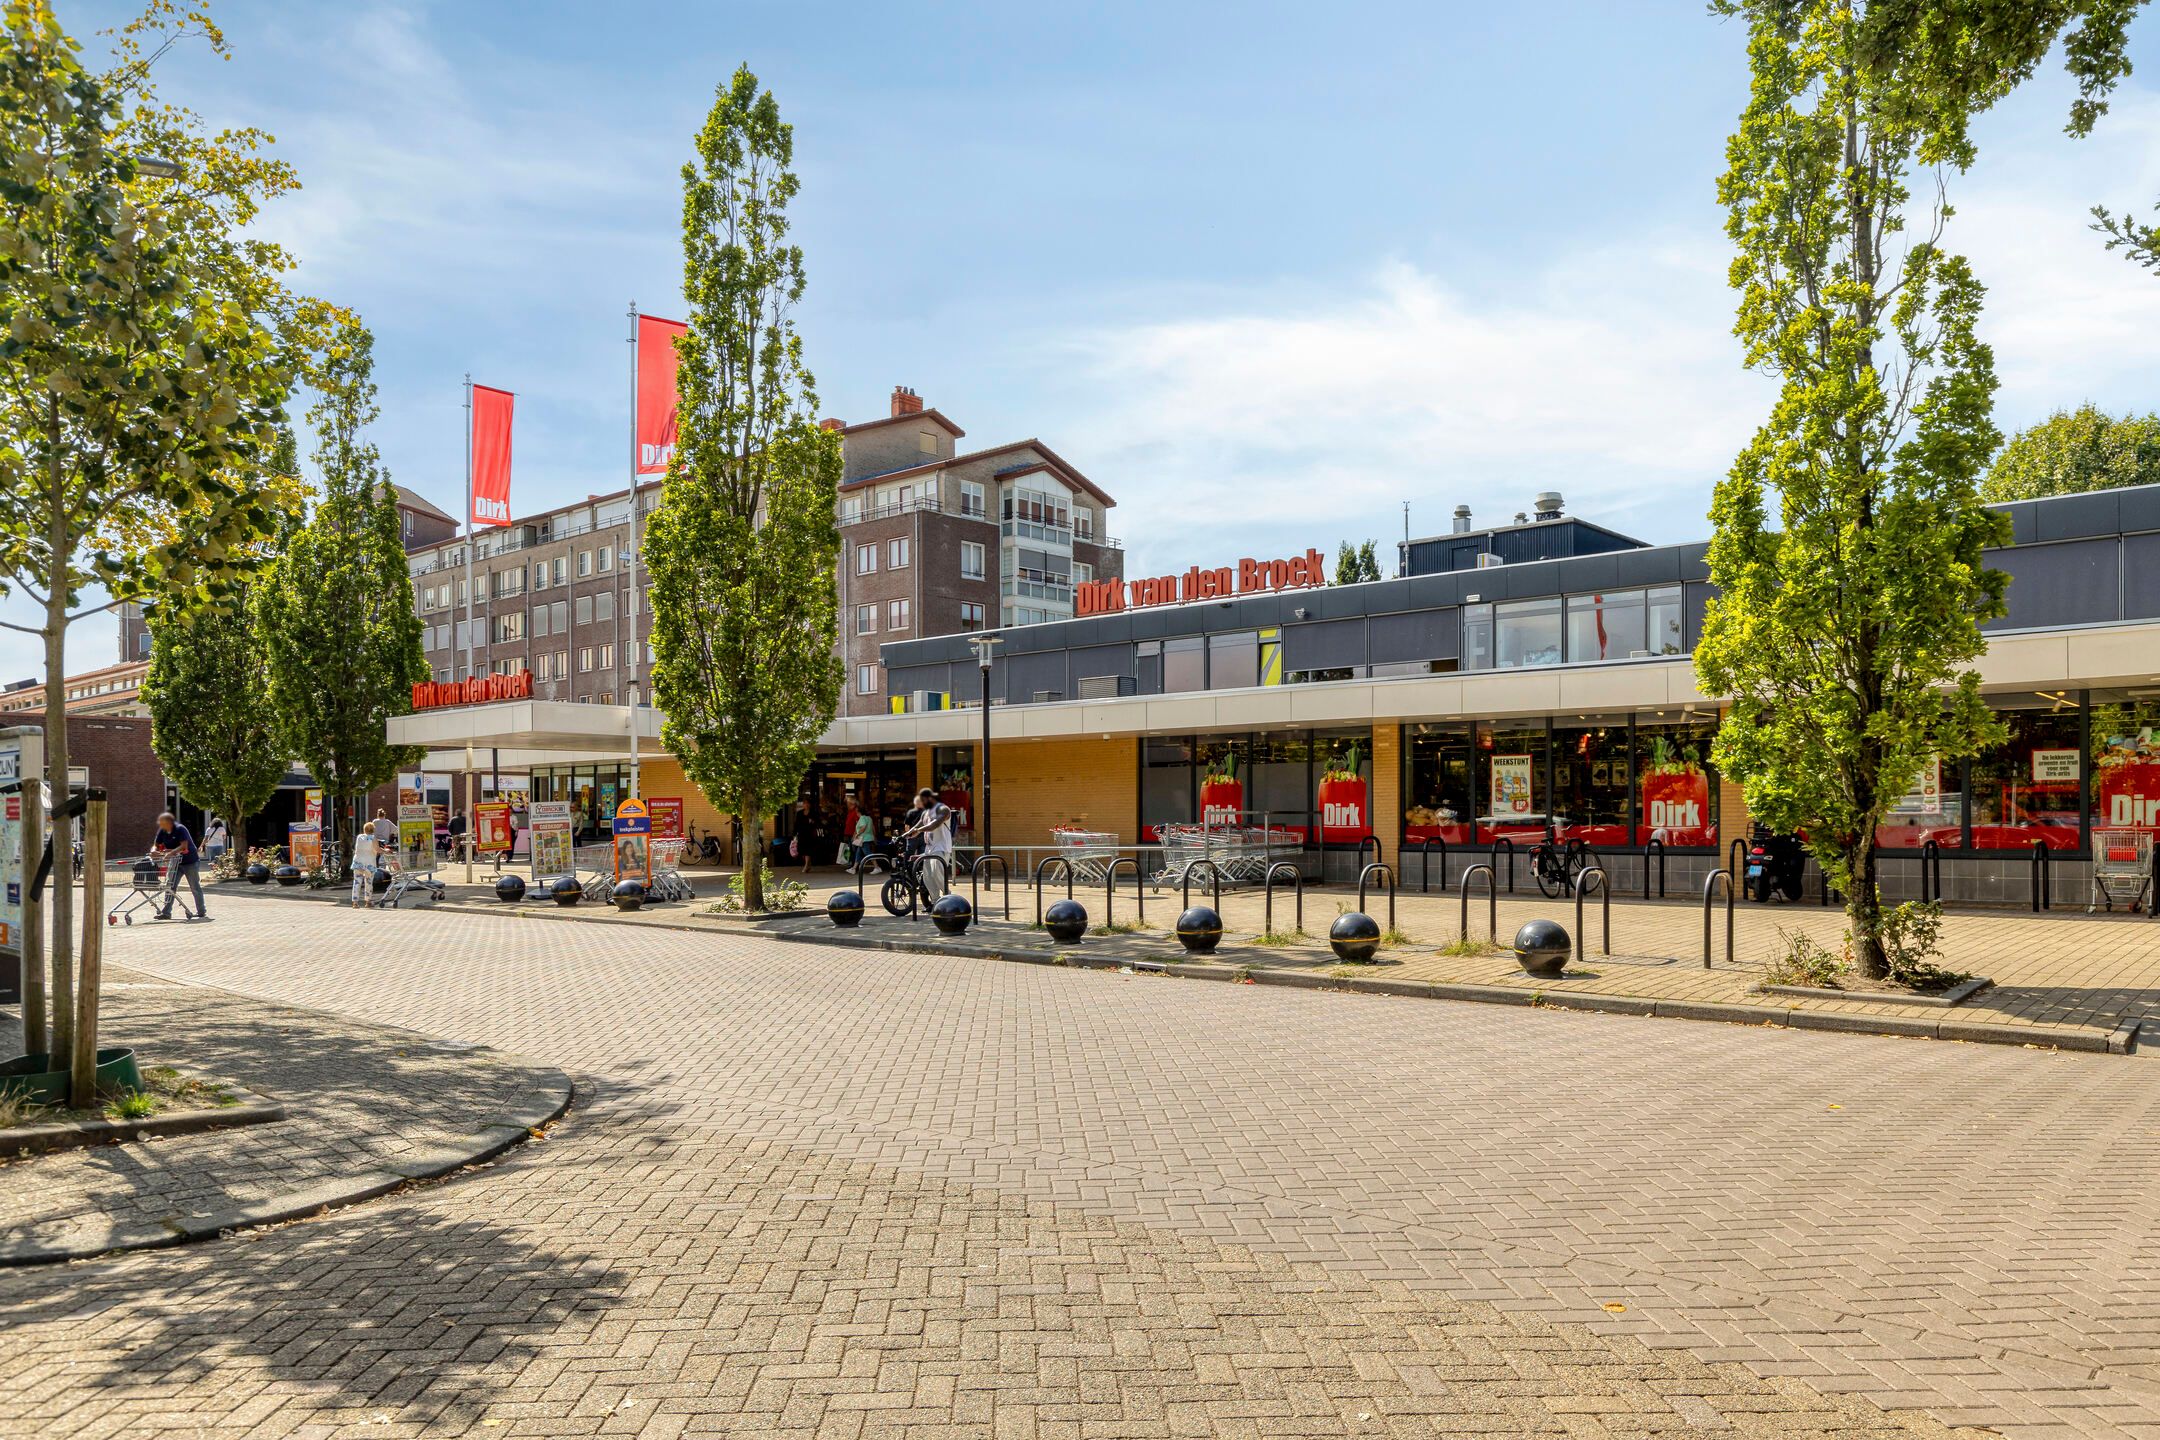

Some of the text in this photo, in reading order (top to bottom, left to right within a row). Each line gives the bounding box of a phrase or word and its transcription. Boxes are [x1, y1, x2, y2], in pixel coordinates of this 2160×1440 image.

[475, 496, 507, 519] Dirk
[1077, 548, 1325, 615] Dirk van den Broek
[412, 669, 533, 708] Dirk van den Broek
[1494, 758, 1529, 766] WEEKSTUNT
[1205, 804, 1237, 825] Dirk
[1324, 803, 1360, 826] Dirk
[1651, 800, 1701, 827] Dirk
[2111, 794, 2160, 826] Dir
